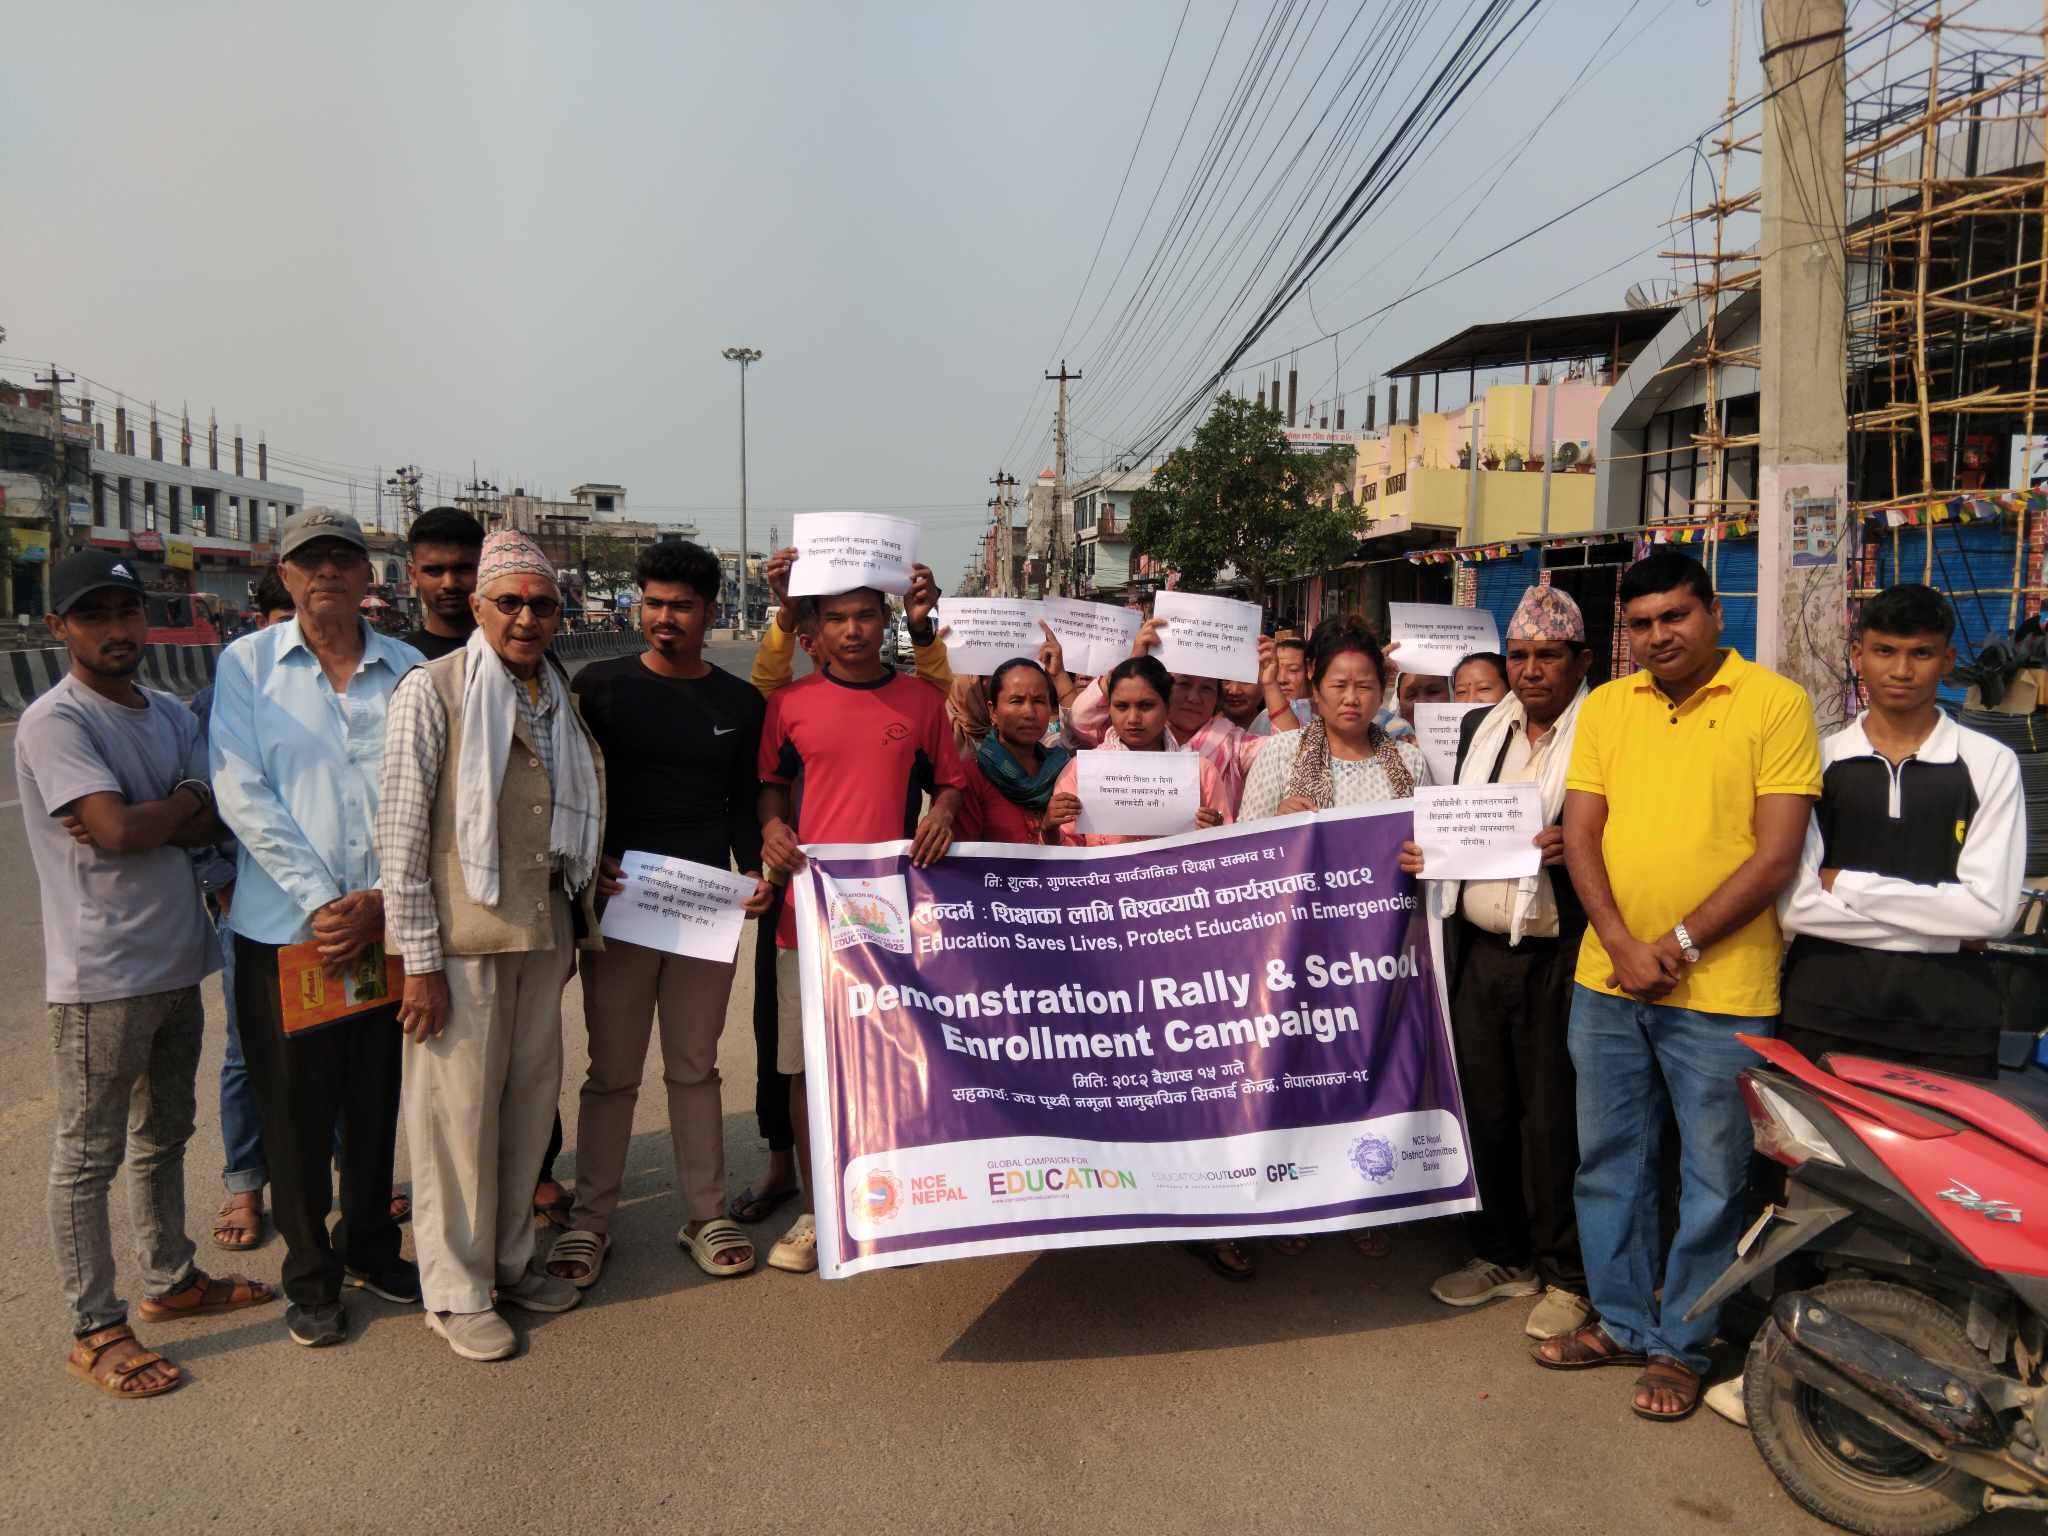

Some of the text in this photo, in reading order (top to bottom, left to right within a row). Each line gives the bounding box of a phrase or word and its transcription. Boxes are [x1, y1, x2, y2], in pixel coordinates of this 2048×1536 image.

[1007, 875, 1043, 893] शुल्क,
[1047, 871, 1111, 892] गुणस्तरीय
[1115, 862, 1178, 885] सार्वजनिक
[1182, 857, 1216, 874] शिक्षा
[1220, 849, 1259, 868] सम्भव
[1263, 848, 1276, 861] छ
[915, 900, 976, 926] सन्दर्भ
[991, 901, 1062, 926] शिक्षाका
[1067, 900, 1115, 925] लागि
[1119, 887, 1211, 921] विश्वव्यापी
[1324, 867, 1375, 890] २०८२
[919, 932, 1011, 954] Education
[1015, 933, 1066, 952] Saves
[1070, 935, 1123, 952] Lives,
[1126, 924, 1193, 948] Protect
[1196, 910, 1286, 939] Education
[1291, 904, 1309, 921] in
[1313, 893, 1418, 921] Emergencies
[1266, 958, 1297, 992] &
[1304, 945, 1420, 989] School
[940, 1001, 1360, 1062] Enrollment Campaign
[1112, 1071, 1149, 1088] २०८२
[1222, 1060, 1246, 1077] गते
[1013, 1092, 1036, 1105] जय
[1039, 1093, 1071, 1110] पृथ्वी
[1075, 1095, 1112, 1112] नमूना
[1117, 1091, 1187, 1112] सामुदायिक
[1412, 1135, 1426, 1146] NCE
[987, 1155, 1089, 1169] GLOBAL CAMPAIGN FOR
[1401, 1145, 1459, 1161] District Committee
[911, 1174, 947, 1191] NCE
[988, 1166, 1137, 1196] EDUCATION
[1266, 1162, 1299, 1183] GPE
[912, 1187, 968, 1206] NEPAL
